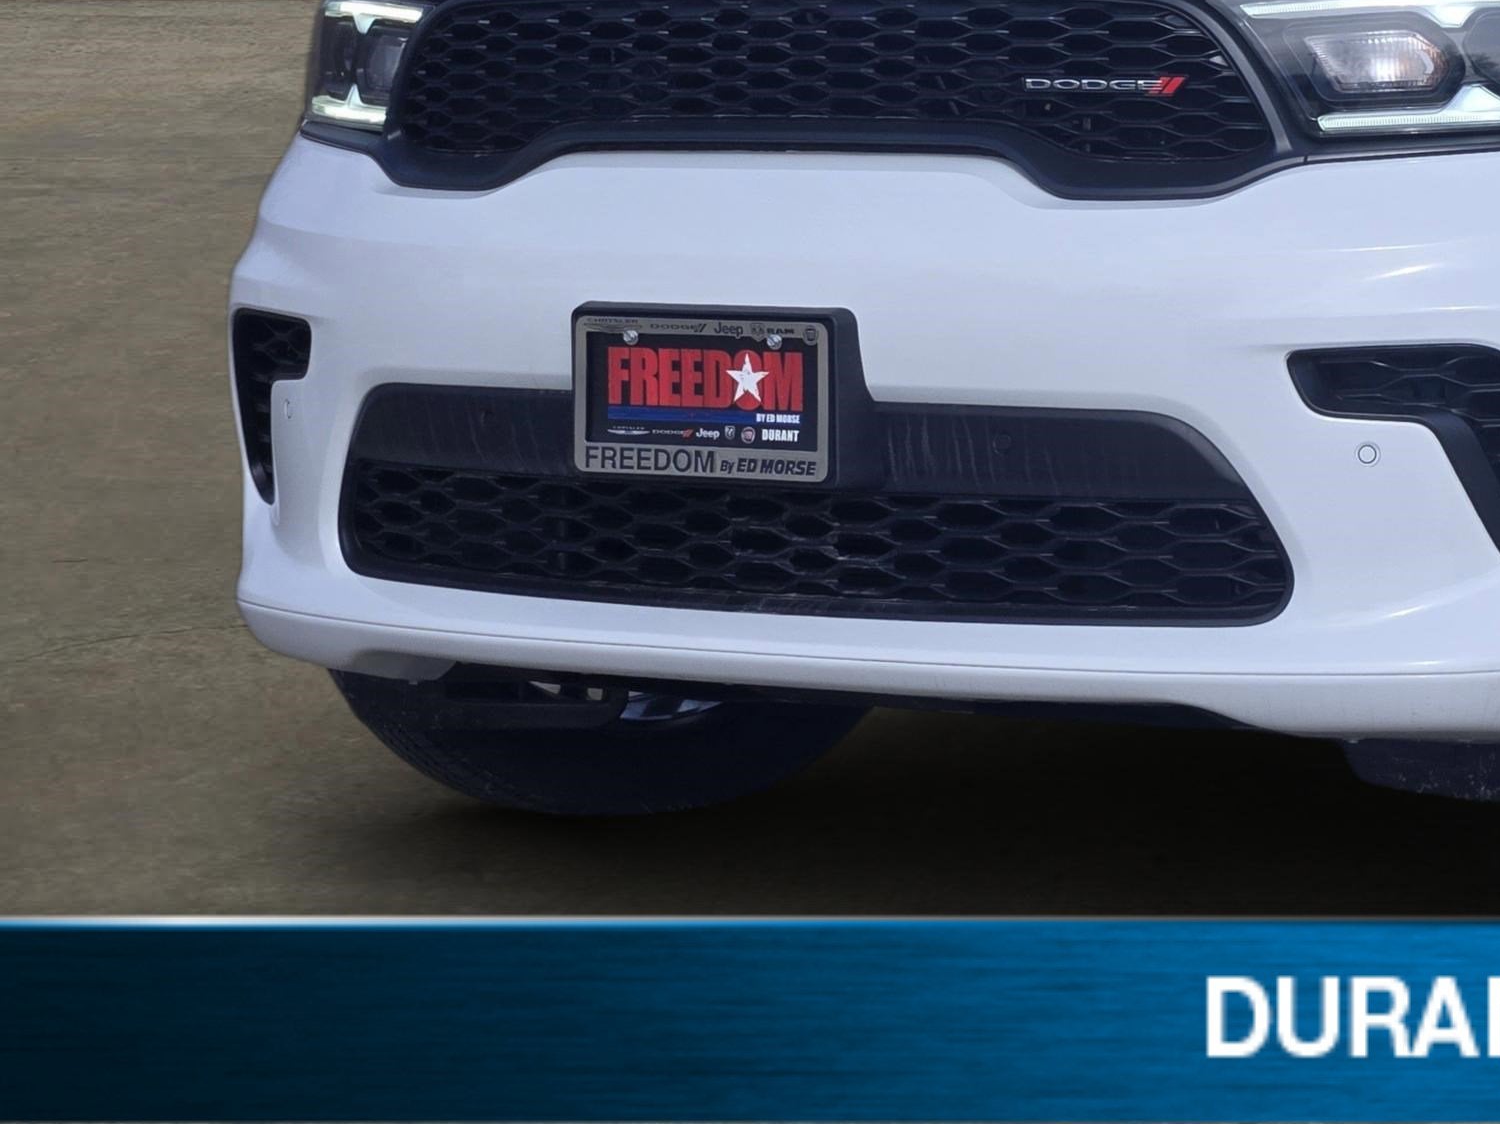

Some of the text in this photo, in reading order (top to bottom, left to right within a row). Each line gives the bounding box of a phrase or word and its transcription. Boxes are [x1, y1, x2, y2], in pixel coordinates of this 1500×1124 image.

[1024, 78, 1164, 91] DODGE
[713, 322, 744, 338] Jeep
[766, 327, 795, 335] RAM
[607, 346, 804, 412] FREEDOM
[756, 413, 801, 424] BY ED MORSE
[695, 428, 720, 440] Jeep
[761, 428, 800, 442] DURANT
[585, 446, 817, 476] FREEDOM By ED MORSE
